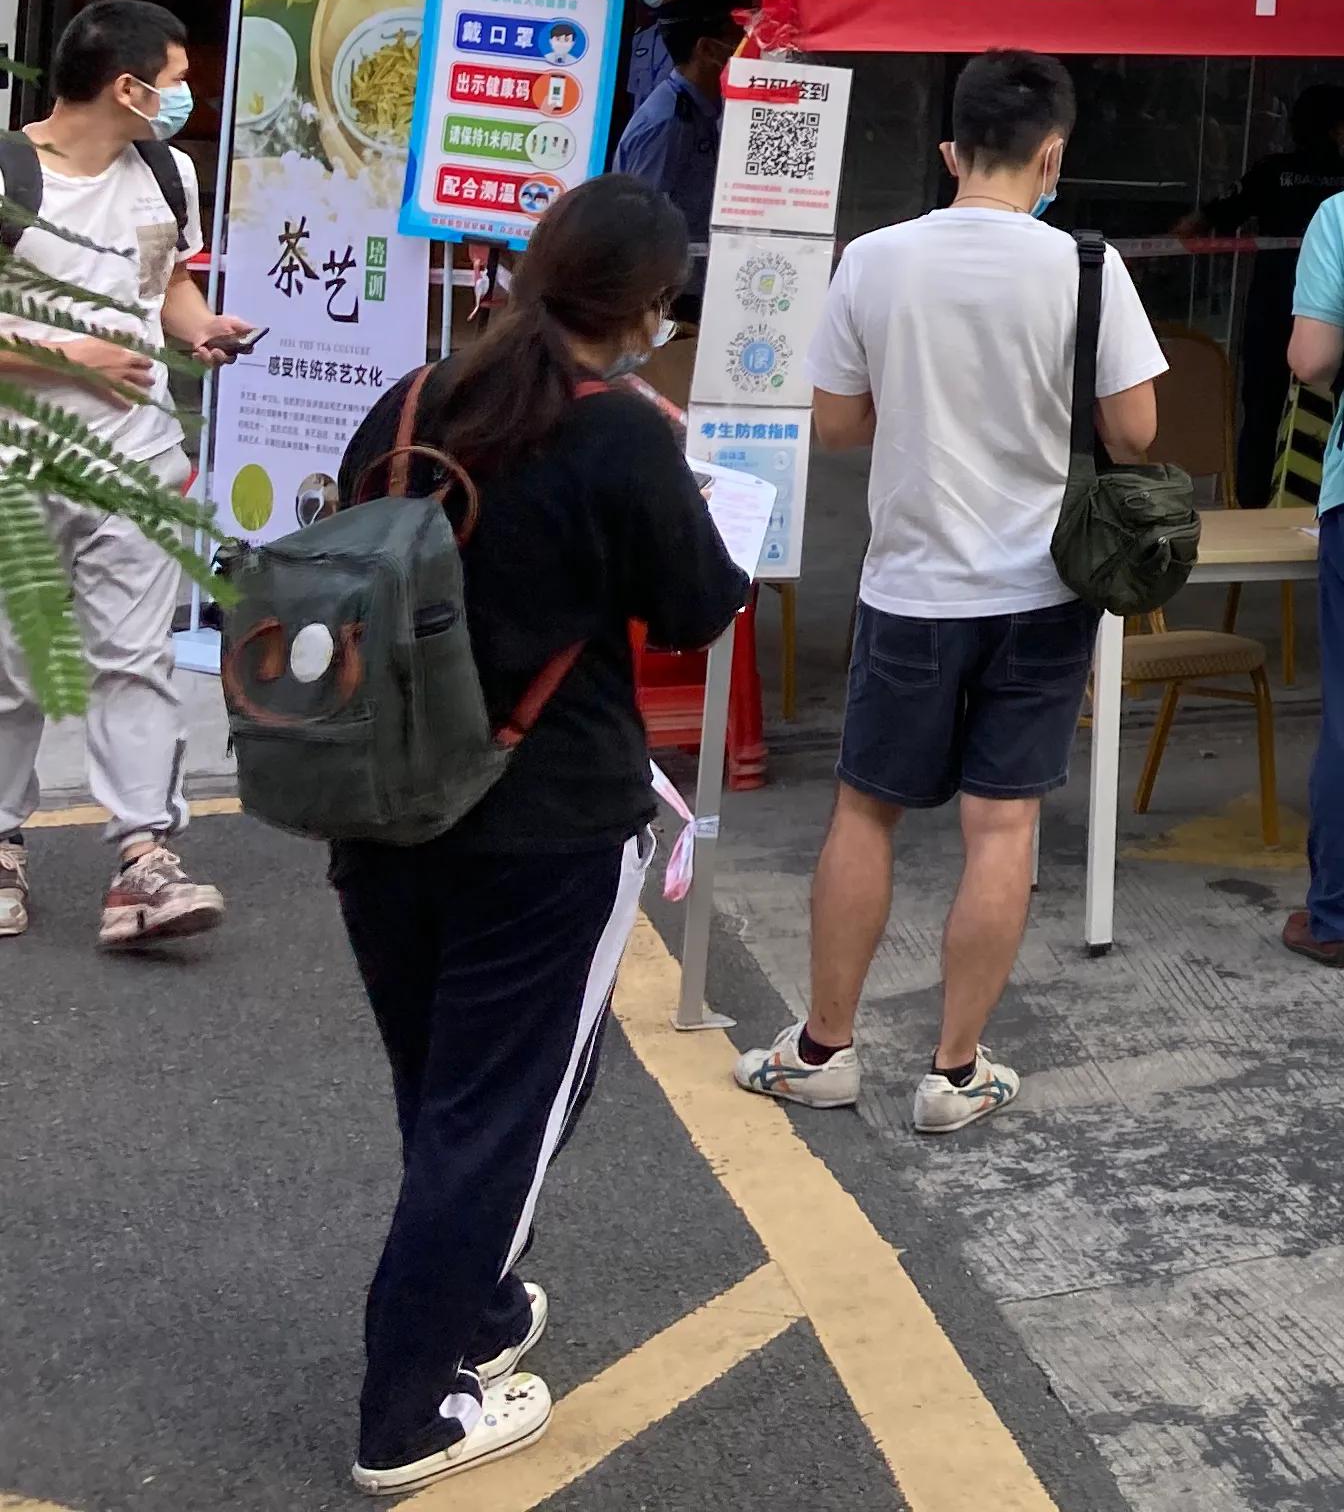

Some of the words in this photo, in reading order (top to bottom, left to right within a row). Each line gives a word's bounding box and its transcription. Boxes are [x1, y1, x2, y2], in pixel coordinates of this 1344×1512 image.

[461, 20, 535, 49] 戴口罩
[455, 71, 531, 102] 出示健康码
[448, 124, 525, 154] 请保持1米间距
[441, 174, 516, 205] 配合测温
[268, 216, 360, 324] 茶艺
[367, 239, 386, 300] 培训
[267, 355, 384, 387] 感受传统茶艺文化
[700, 422, 800, 440] 考生防疫指南
